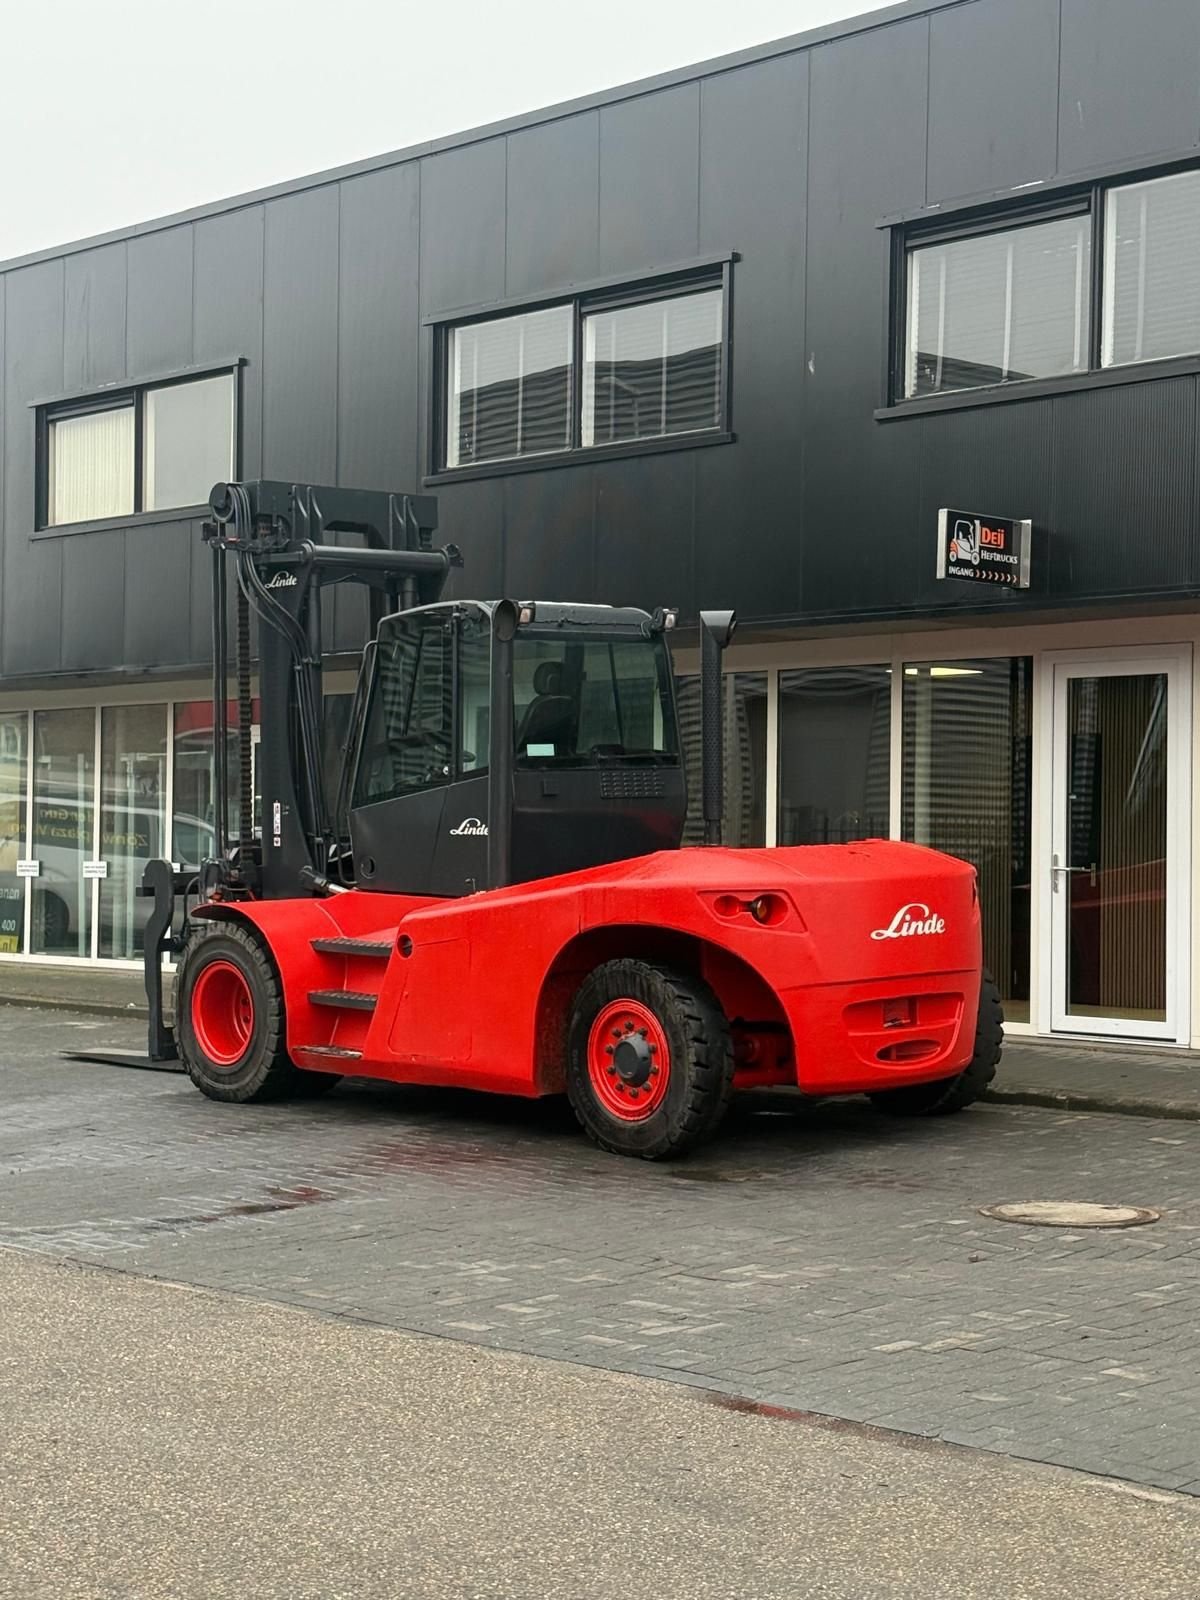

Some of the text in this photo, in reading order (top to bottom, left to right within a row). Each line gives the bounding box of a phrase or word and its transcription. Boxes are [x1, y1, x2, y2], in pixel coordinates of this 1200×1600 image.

[948, 566, 974, 577] INGANG
[264, 570, 297, 589] Linde
[1, 919, 16, 931] 400
[870, 903, 946, 940] Linde
